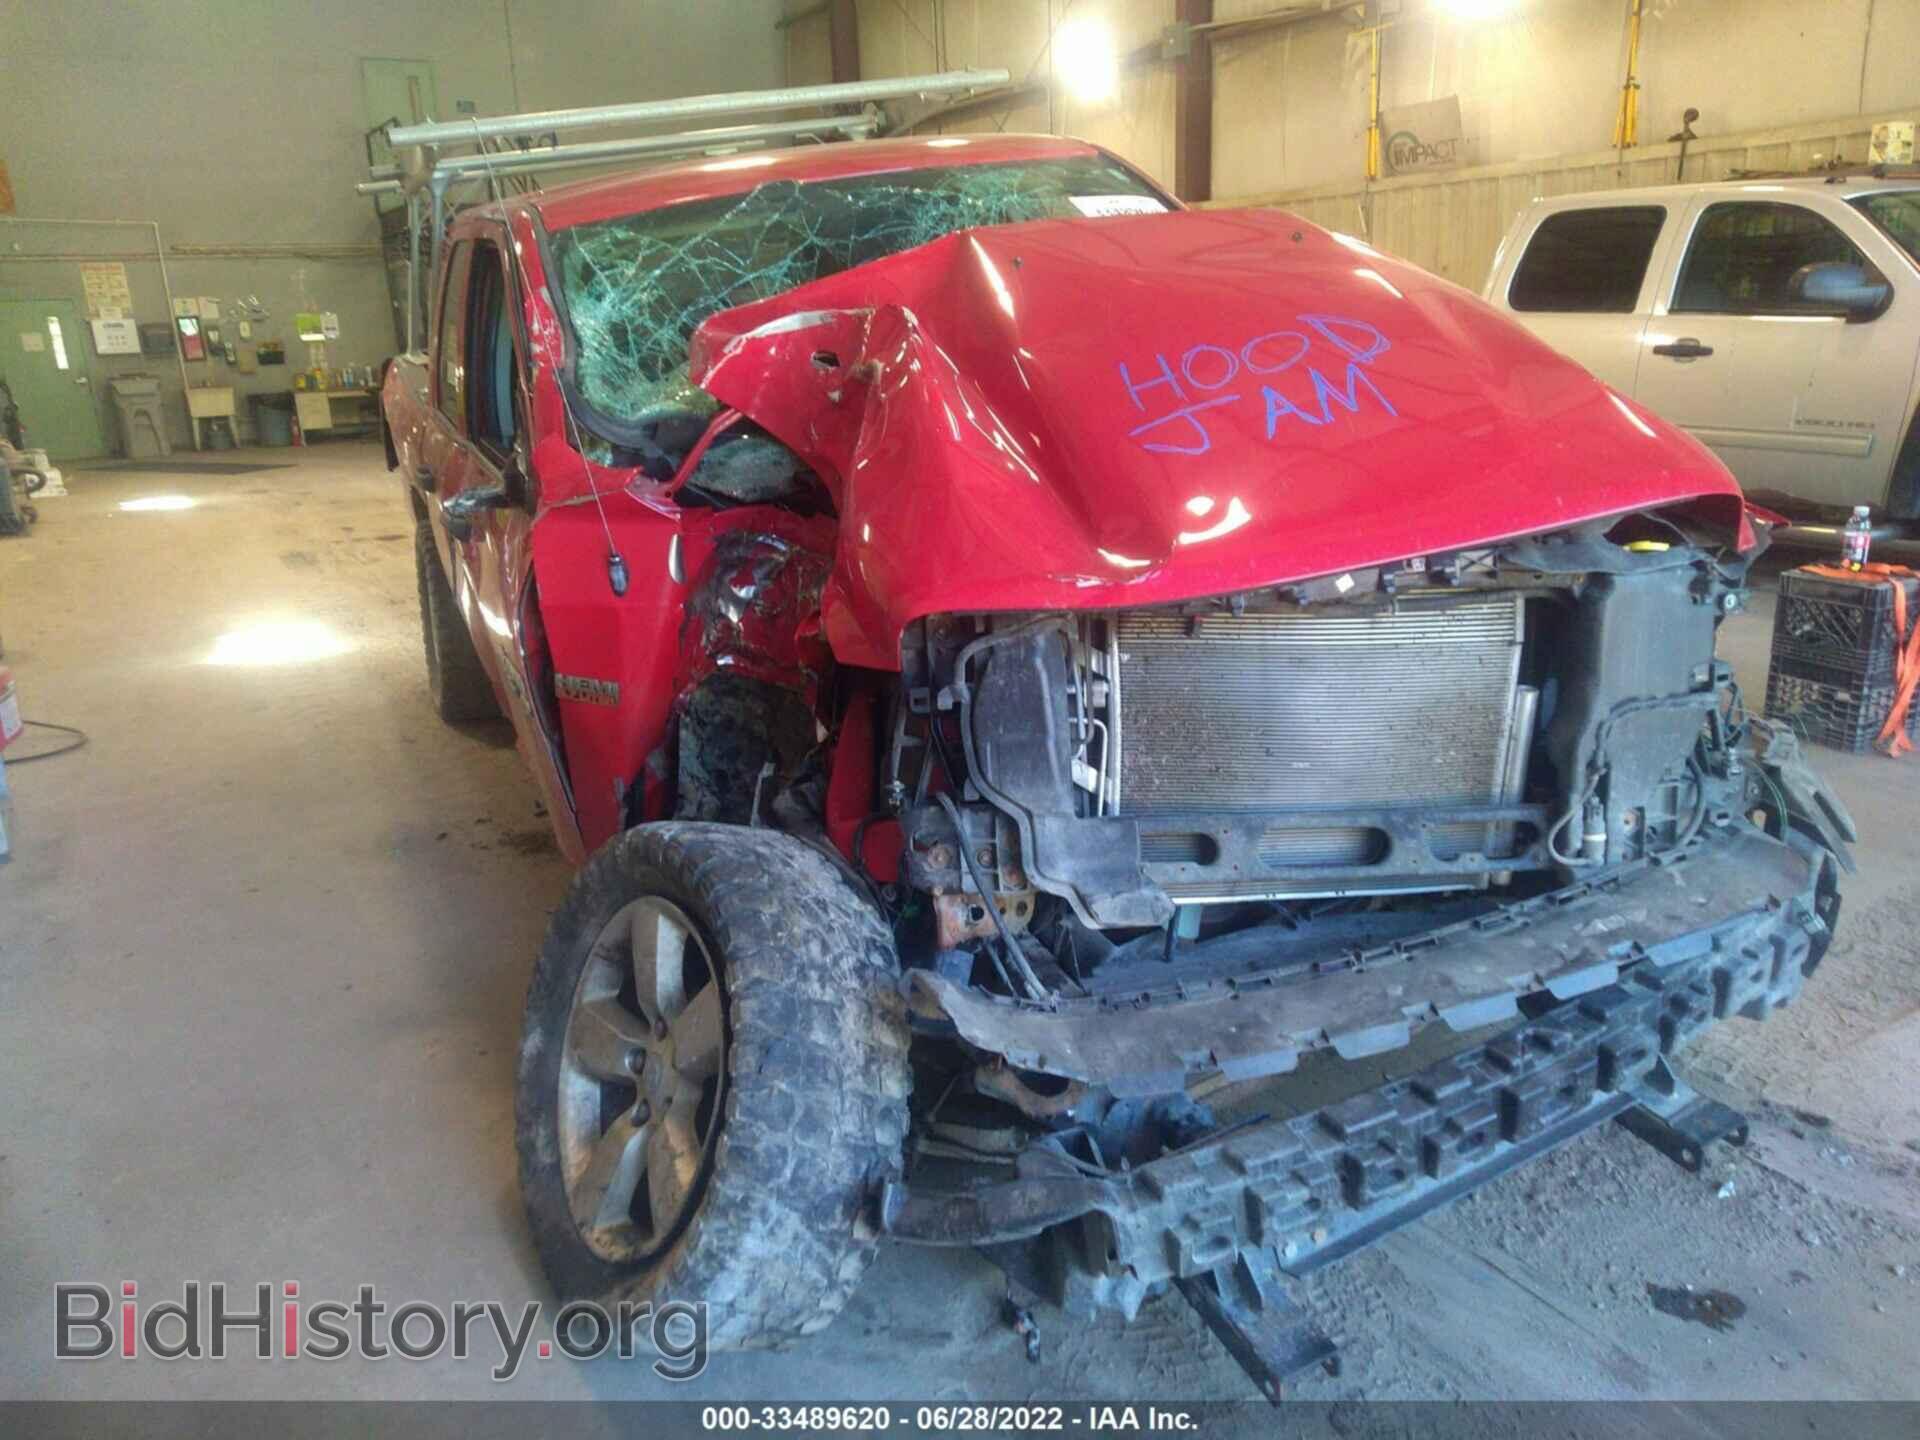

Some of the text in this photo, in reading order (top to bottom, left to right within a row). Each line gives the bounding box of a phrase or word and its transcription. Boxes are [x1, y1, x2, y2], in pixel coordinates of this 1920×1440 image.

[1393, 138, 1458, 168] IMPACT
[1119, 314, 1392, 412] HOOD
[1128, 362, 1399, 456] JAM
